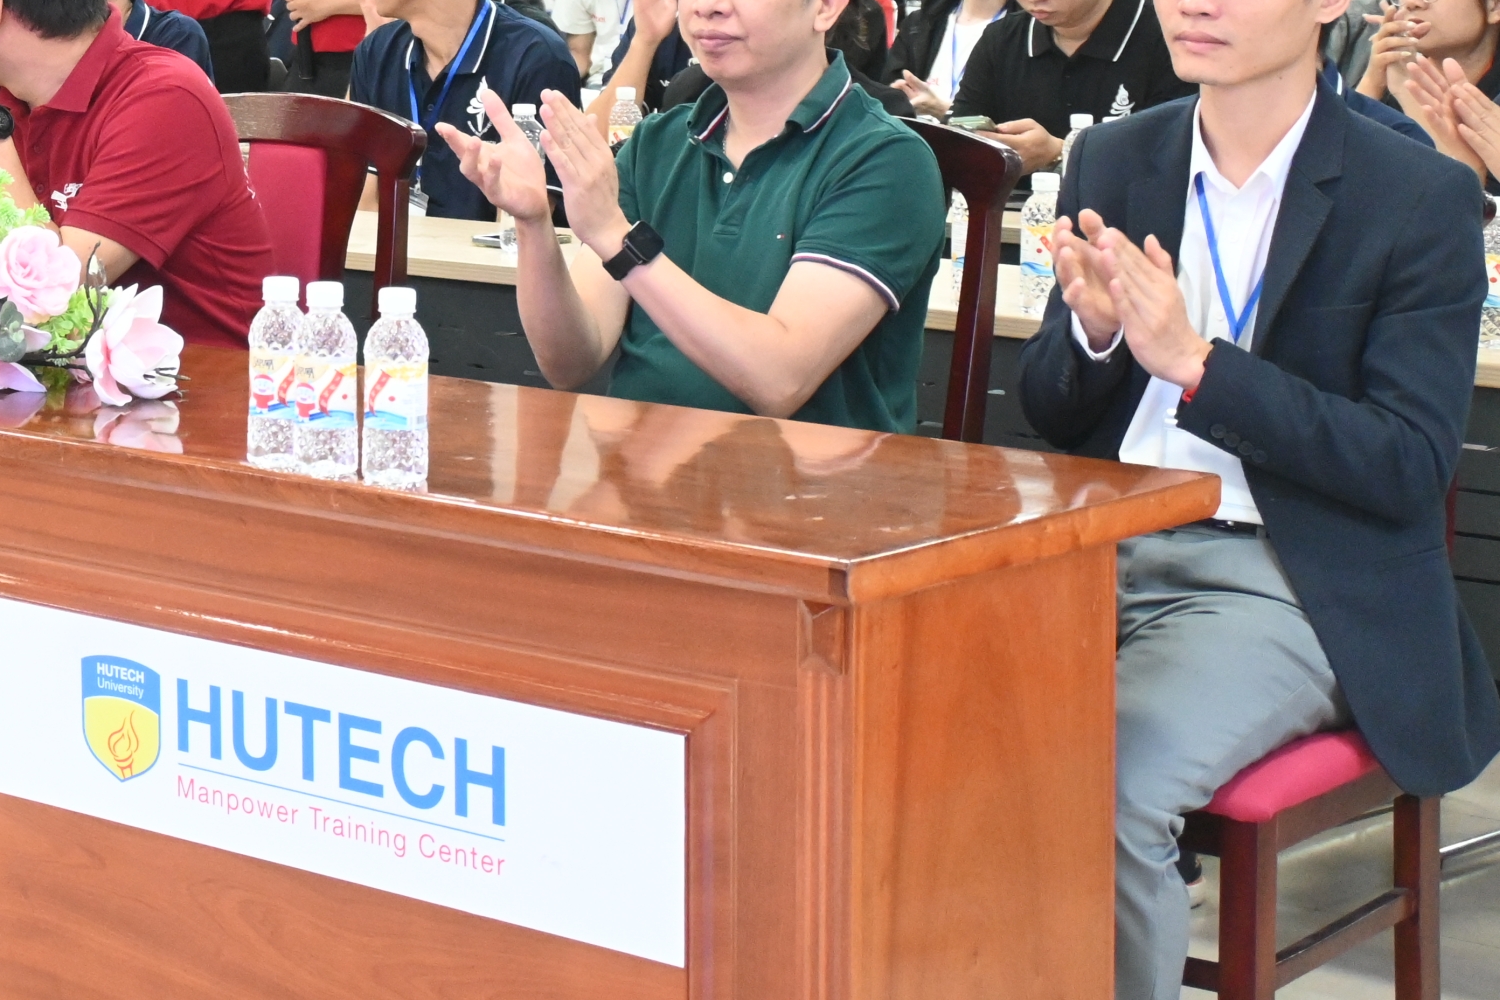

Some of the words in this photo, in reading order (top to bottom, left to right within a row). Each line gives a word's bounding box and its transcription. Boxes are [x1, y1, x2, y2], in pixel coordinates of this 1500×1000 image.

[96, 662, 146, 685] HUTECH
[96, 677, 145, 700] University
[177, 677, 506, 827] HUTECH
[177, 775, 299, 825] Manpower
[309, 805, 407, 858] Training
[418, 833, 506, 876] Center
